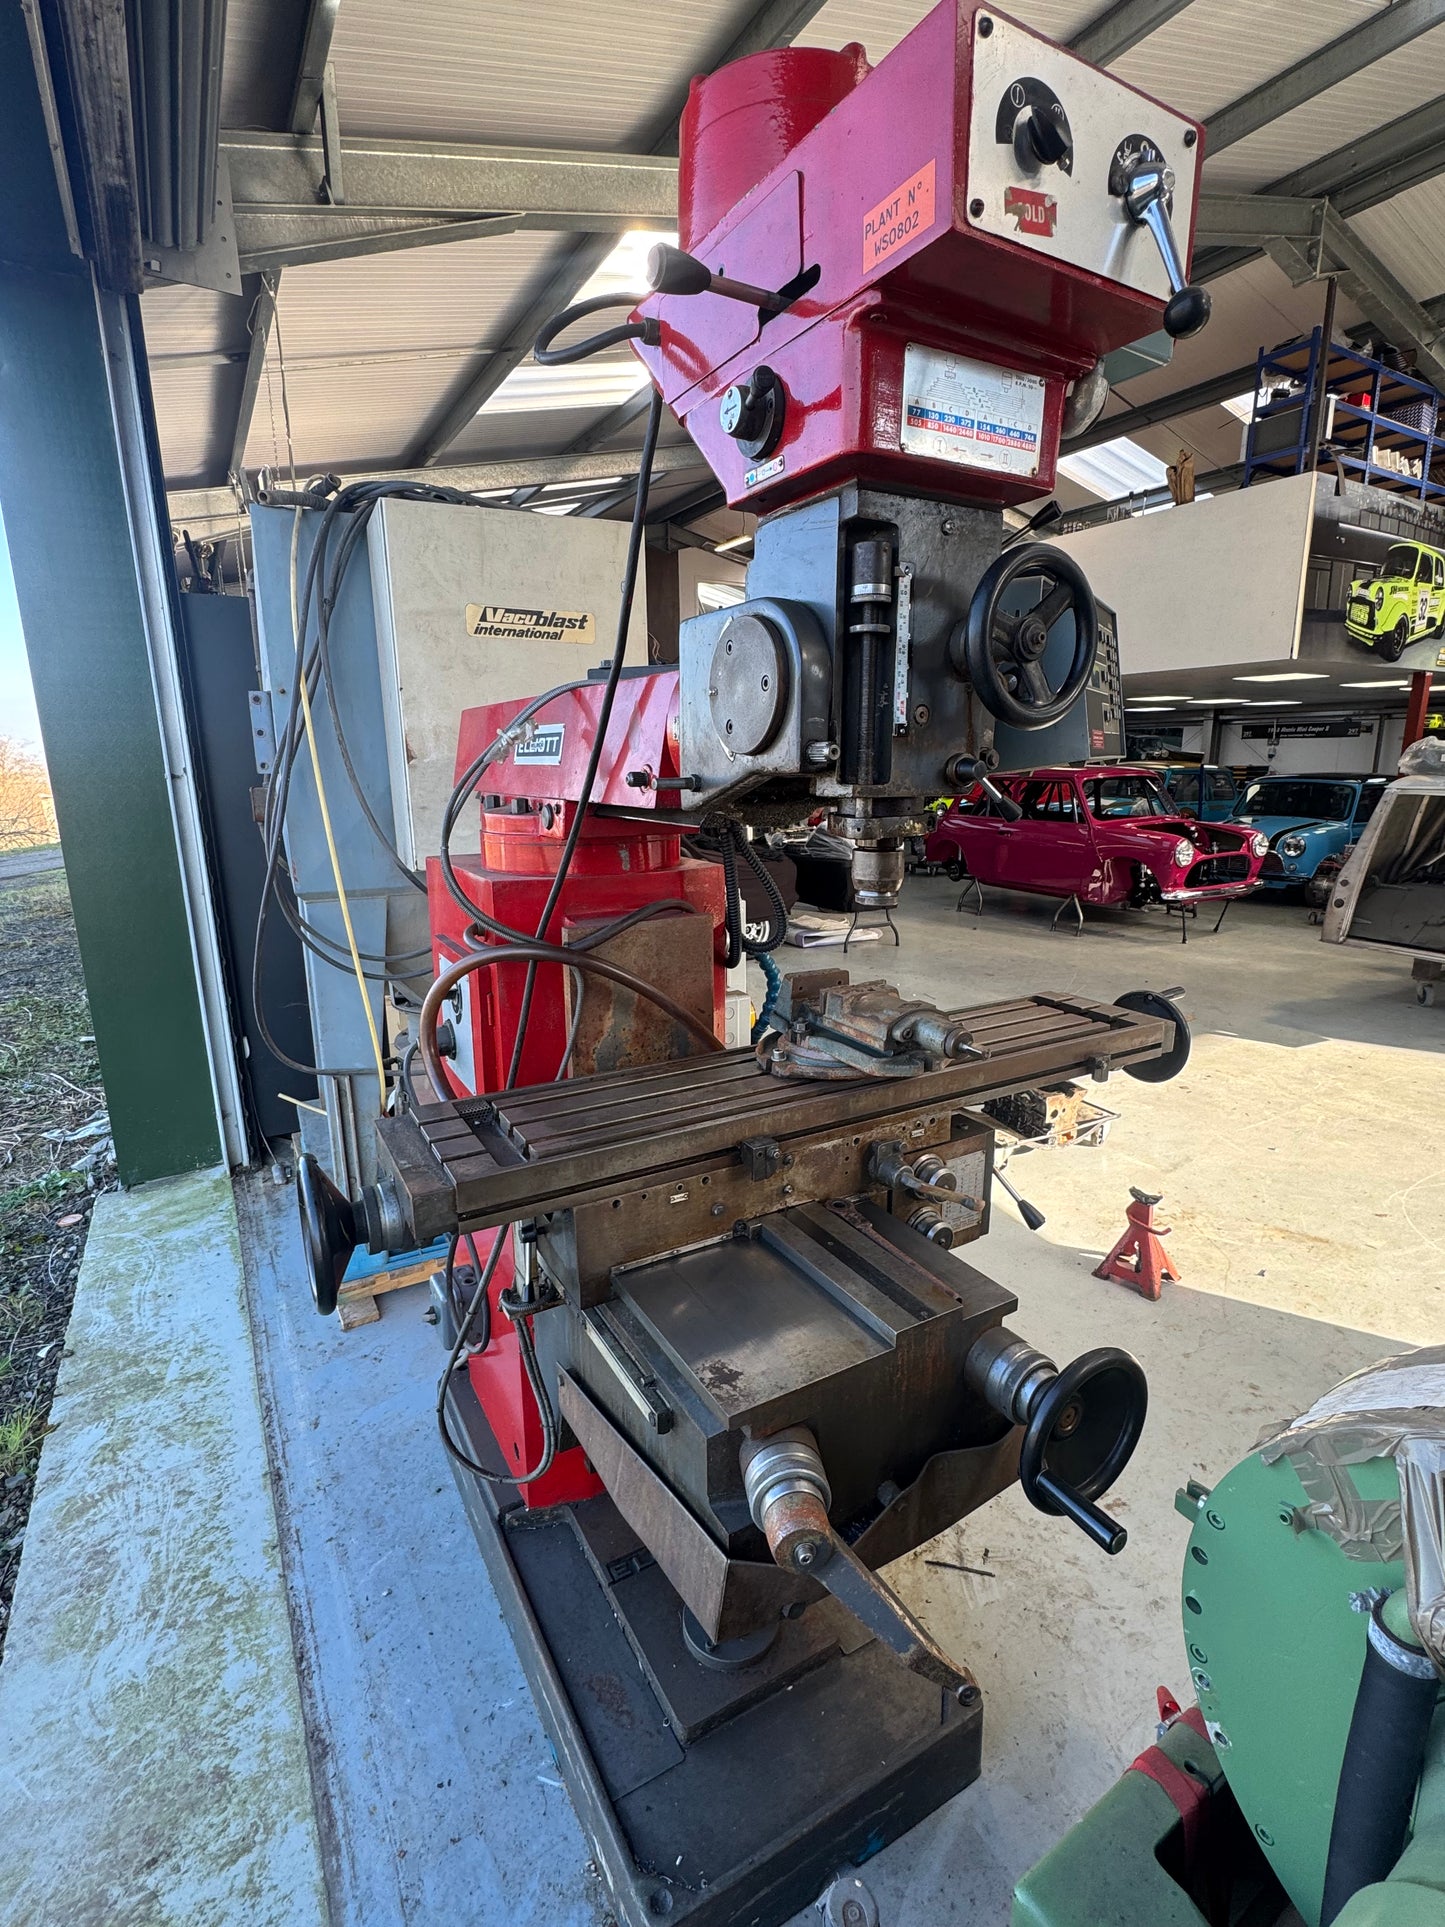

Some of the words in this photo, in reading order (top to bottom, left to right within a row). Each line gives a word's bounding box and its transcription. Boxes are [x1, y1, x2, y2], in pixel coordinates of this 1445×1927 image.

[865, 198, 901, 240] PLANT
[1017, 202, 1045, 223] OLD
[910, 417, 922, 427] 505
[912, 408, 921, 416] 77
[928, 411, 940, 420] 130
[943, 415, 956, 424] 220
[483, 607, 588, 630] Vacublast
[474, 624, 564, 640] international
